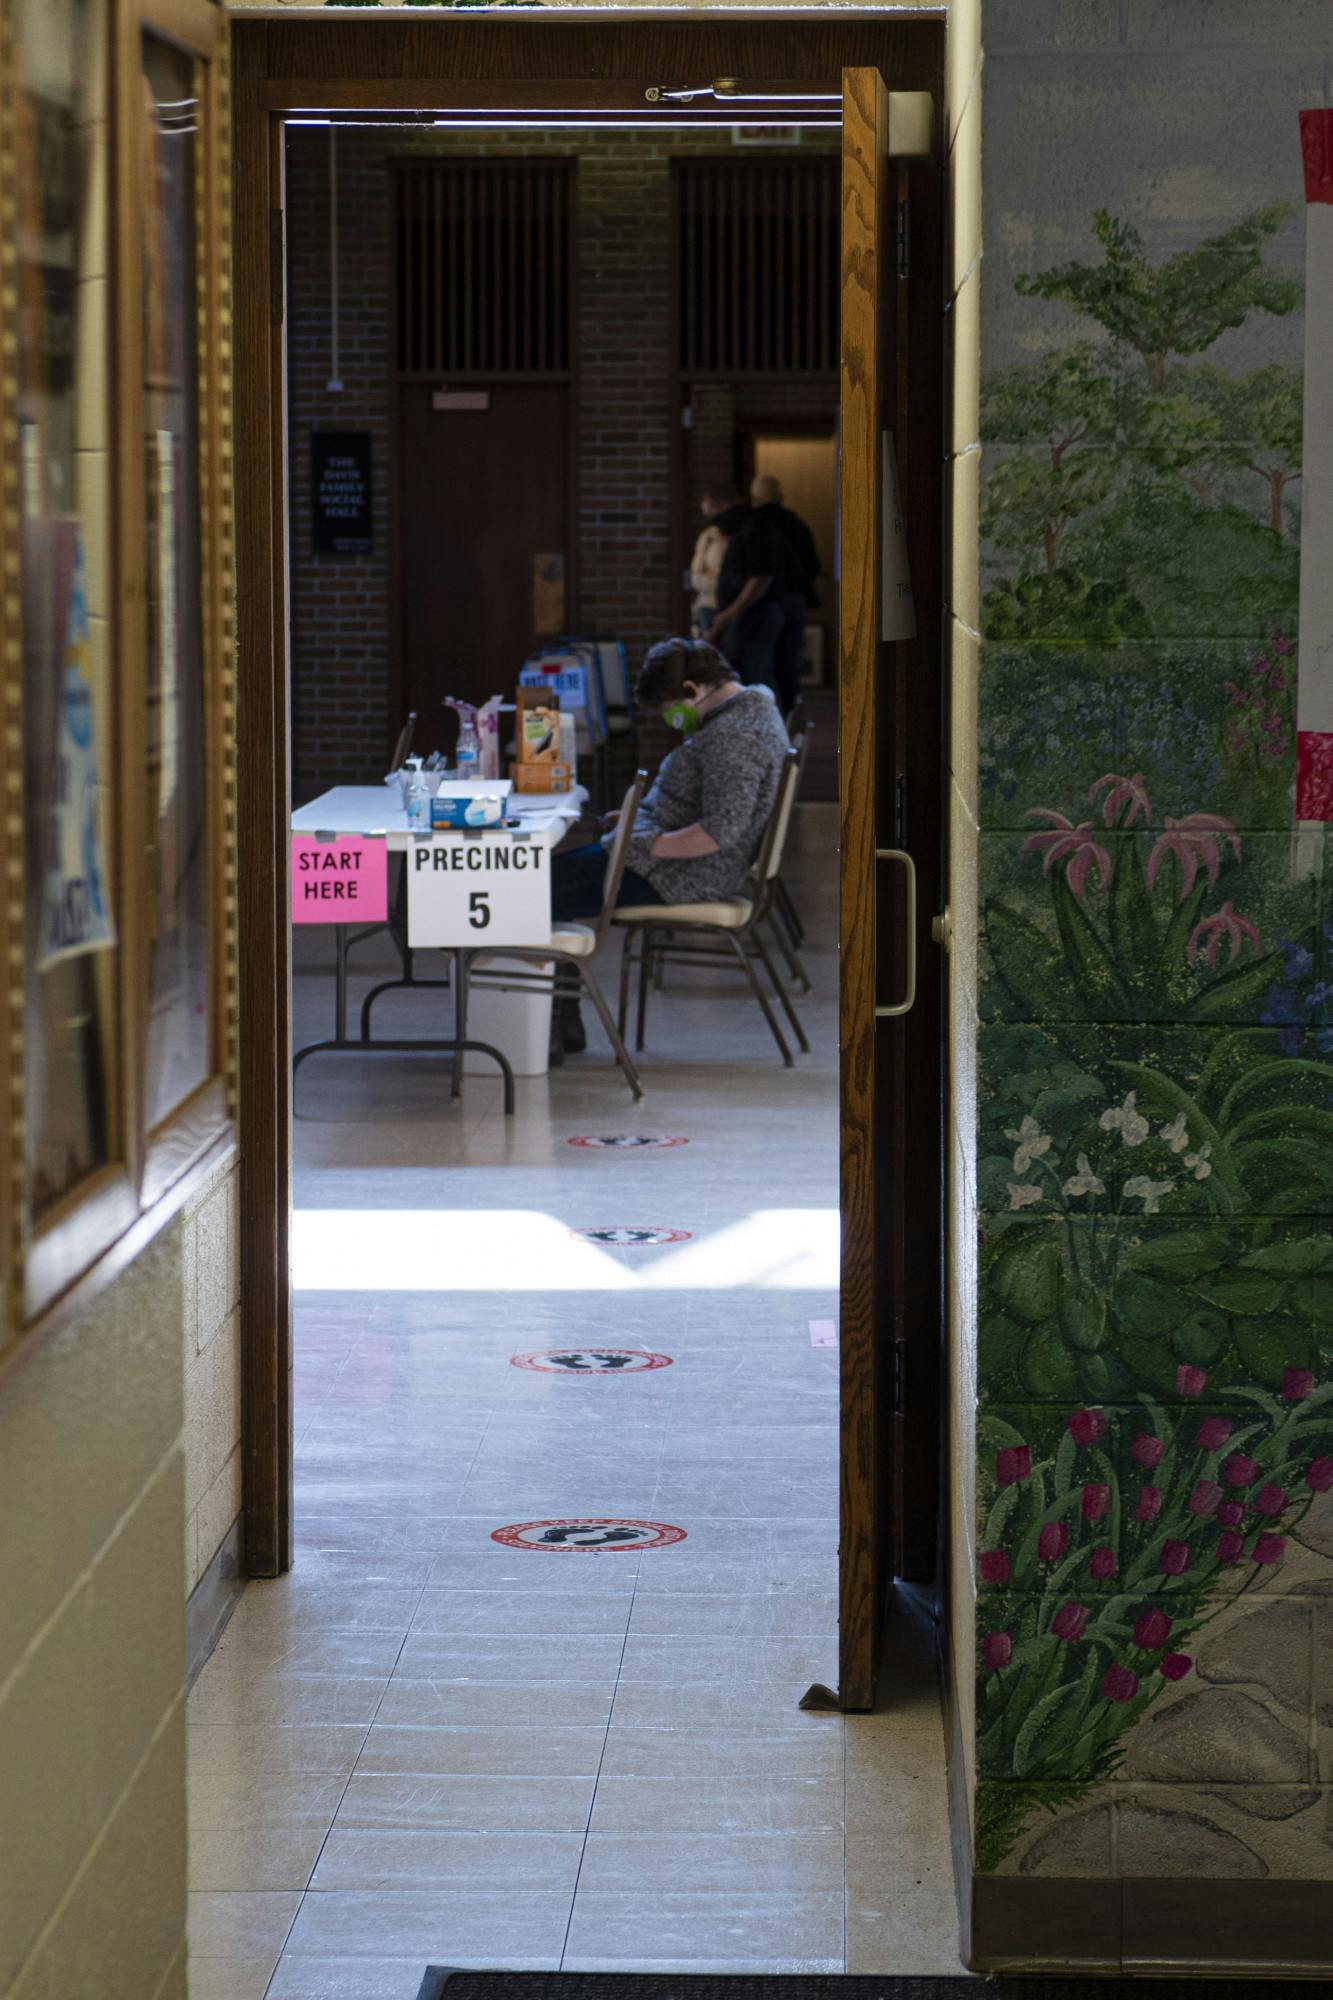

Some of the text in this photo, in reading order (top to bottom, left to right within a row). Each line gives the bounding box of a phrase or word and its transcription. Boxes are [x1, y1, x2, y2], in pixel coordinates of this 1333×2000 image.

[299, 852, 362, 870] START
[416, 847, 543, 870] PRECINCT
[304, 881, 358, 900] HERE
[468, 892, 491, 929] 5
